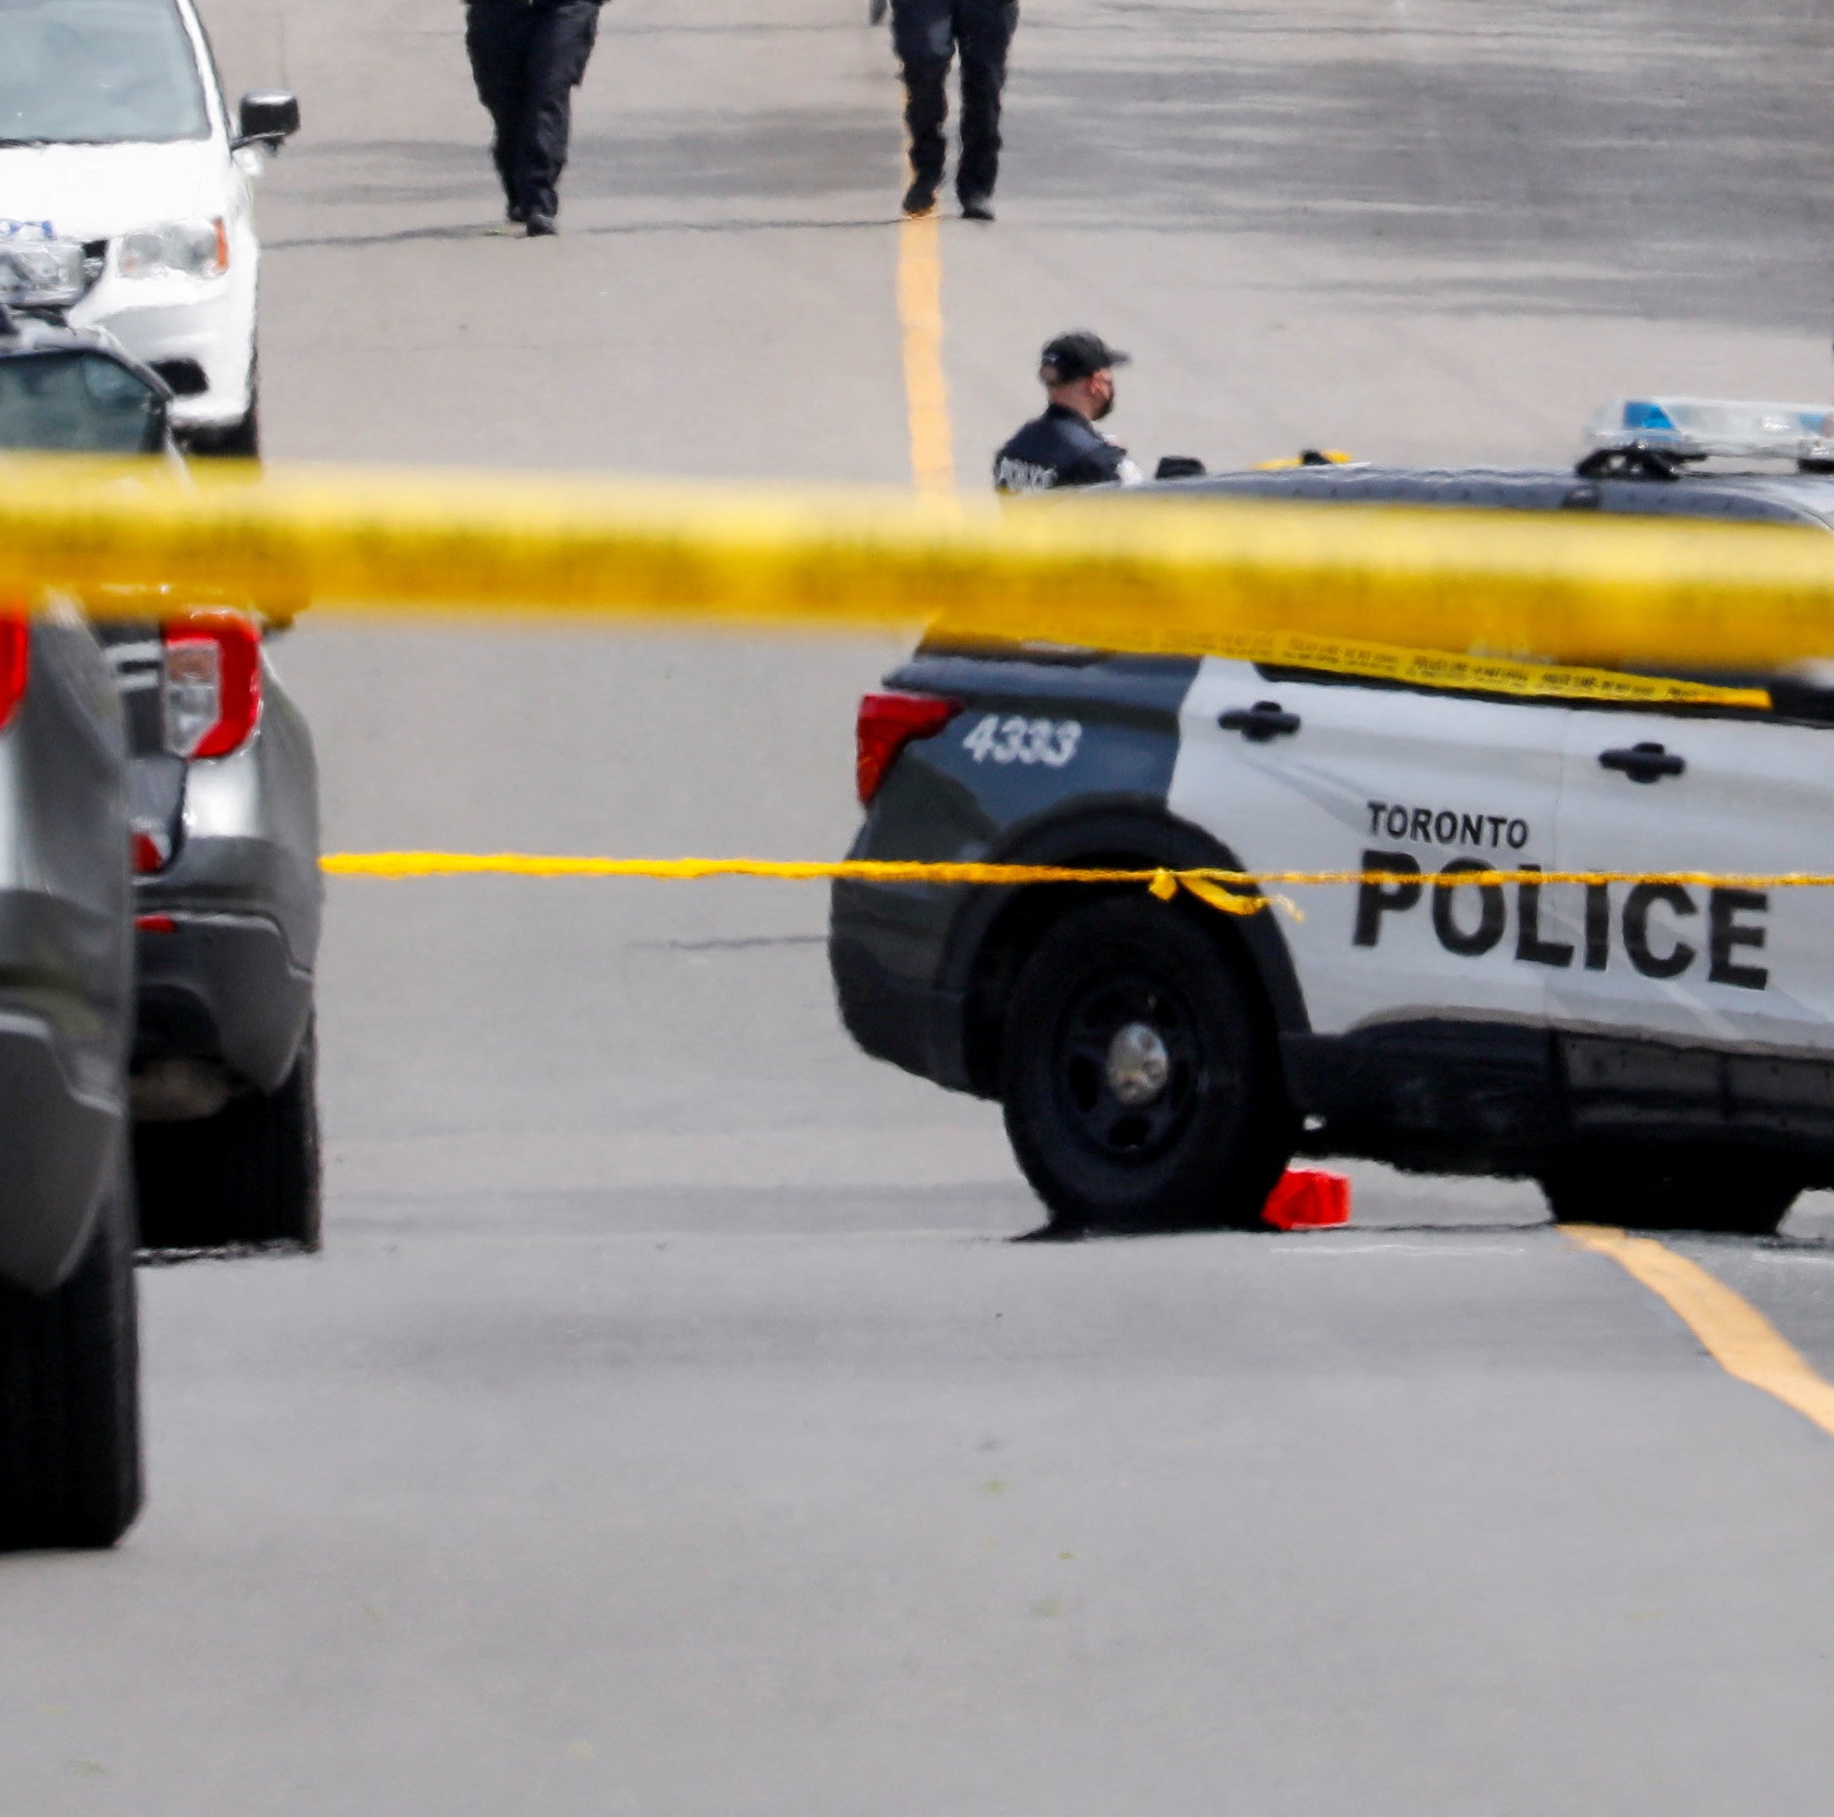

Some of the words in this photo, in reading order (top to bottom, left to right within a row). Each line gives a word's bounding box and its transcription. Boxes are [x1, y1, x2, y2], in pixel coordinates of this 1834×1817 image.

[962, 714, 1081, 767] 4333
[1368, 800, 1529, 850] TORONTO
[1352, 848, 1771, 992] POLICE
